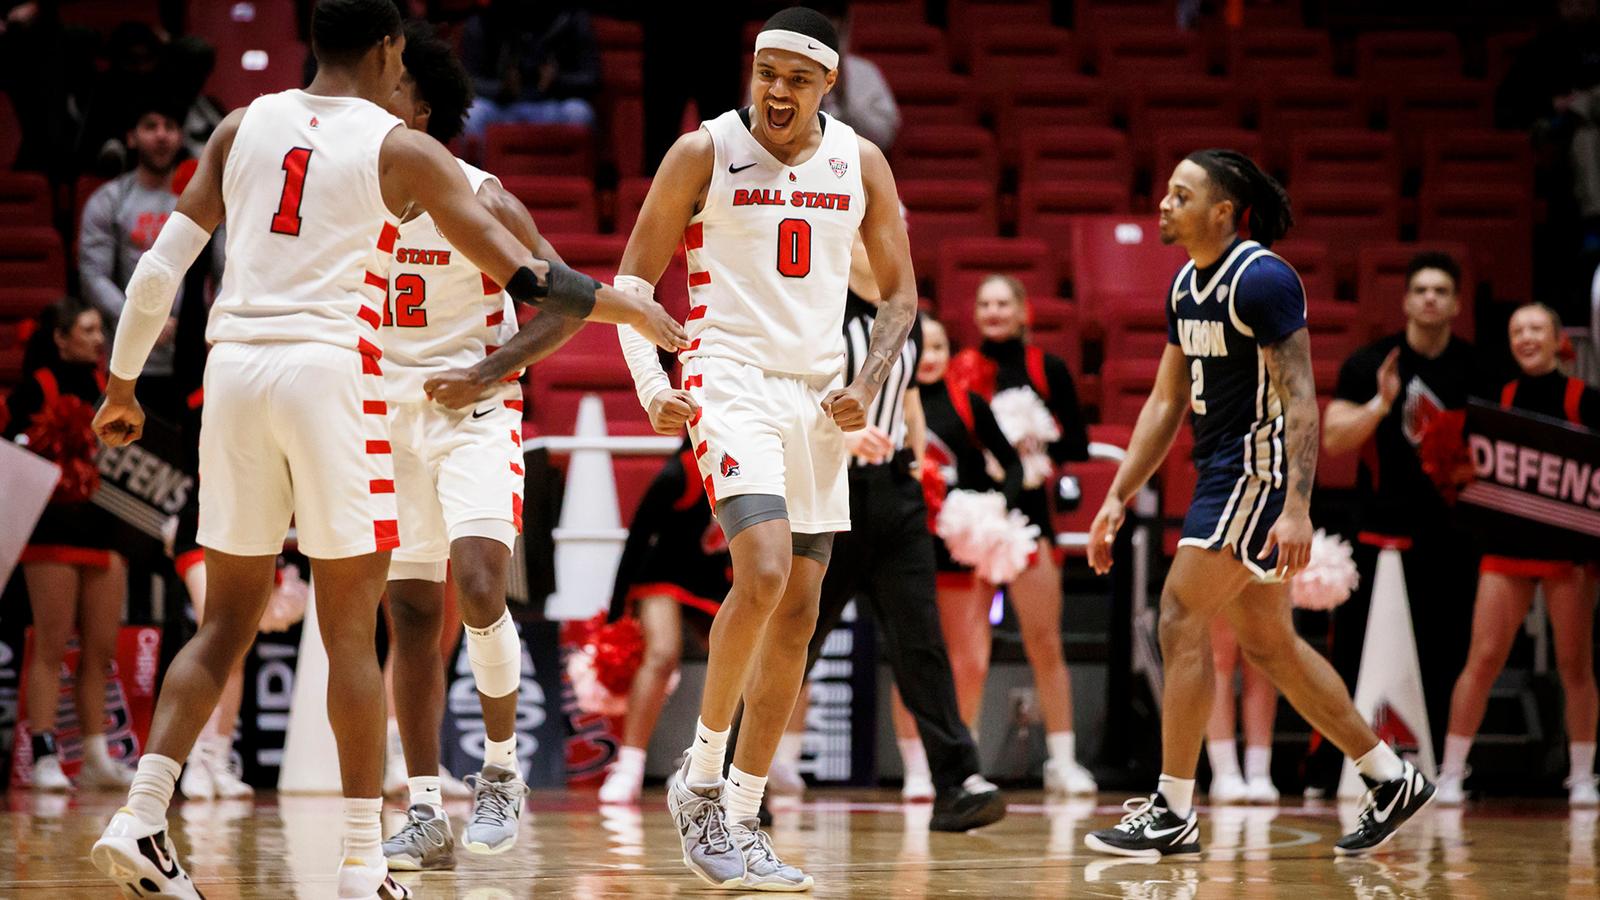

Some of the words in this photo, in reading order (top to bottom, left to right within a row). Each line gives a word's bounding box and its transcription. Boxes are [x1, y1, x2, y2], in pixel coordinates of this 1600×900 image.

[270, 146, 313, 237] 1
[733, 189, 785, 206] BALL
[790, 191, 851, 211] STATE
[396, 247, 451, 266] STATE
[776, 217, 811, 278] 0
[1190, 358, 1207, 416] 2
[98, 443, 194, 514] EFENS
